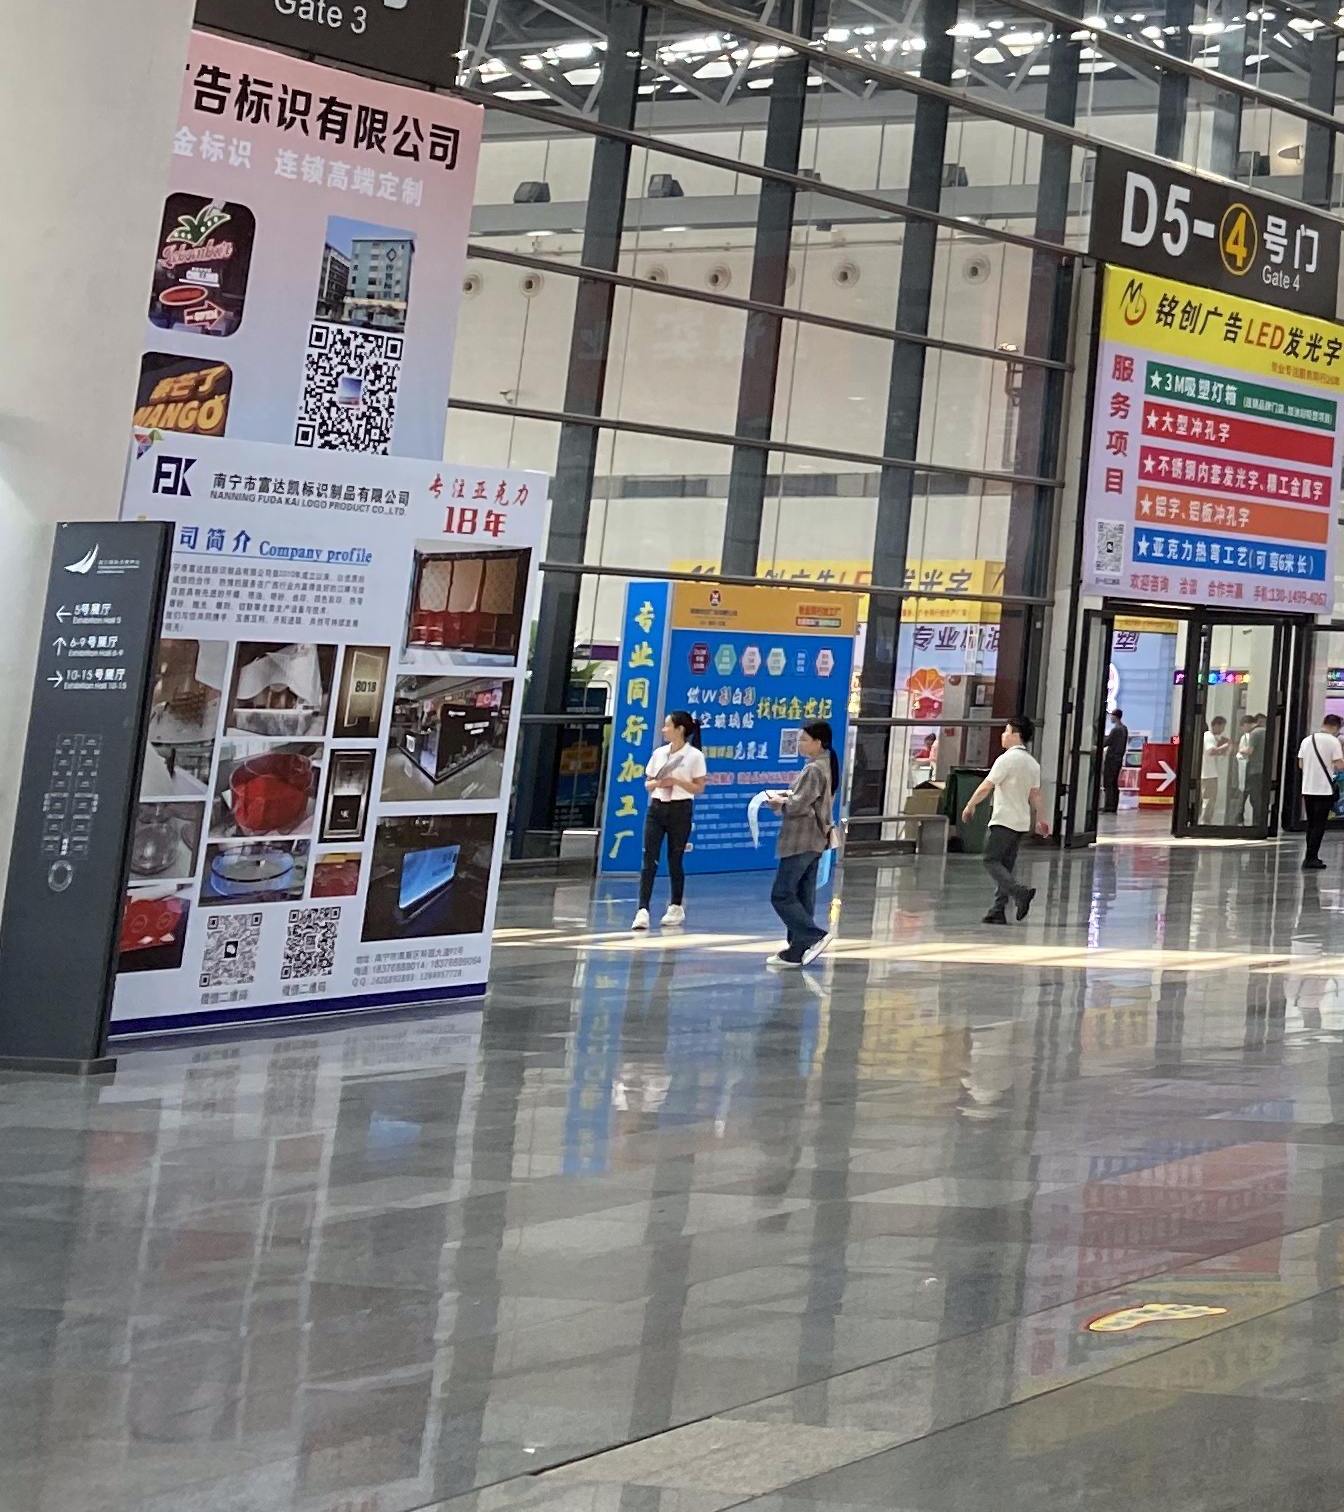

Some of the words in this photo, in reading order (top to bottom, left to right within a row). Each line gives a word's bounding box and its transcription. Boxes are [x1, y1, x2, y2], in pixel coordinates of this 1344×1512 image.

[350, 5, 368, 34] 3
[186, 64, 461, 170] 告标识有限公司
[274, 148, 424, 207] 连锁高端定制
[1262, 266, 1290, 289] Gate
[1292, 274, 1300, 292] 4
[1155, 293, 1344, 367] 铭创广告LED发光字
[1104, 354, 1134, 494] 服务项目
[1162, 412, 1231, 444] 大型冲孔字
[209, 490, 256, 502] NANNING
[328, 501, 371, 514] PRODUCT
[429, 473, 530, 506] 专注亚克力
[443, 506, 508, 538] 18年
[259, 541, 324, 564] Company
[325, 547, 373, 566] profile
[609, 600, 655, 859] 专业同行加工厂
